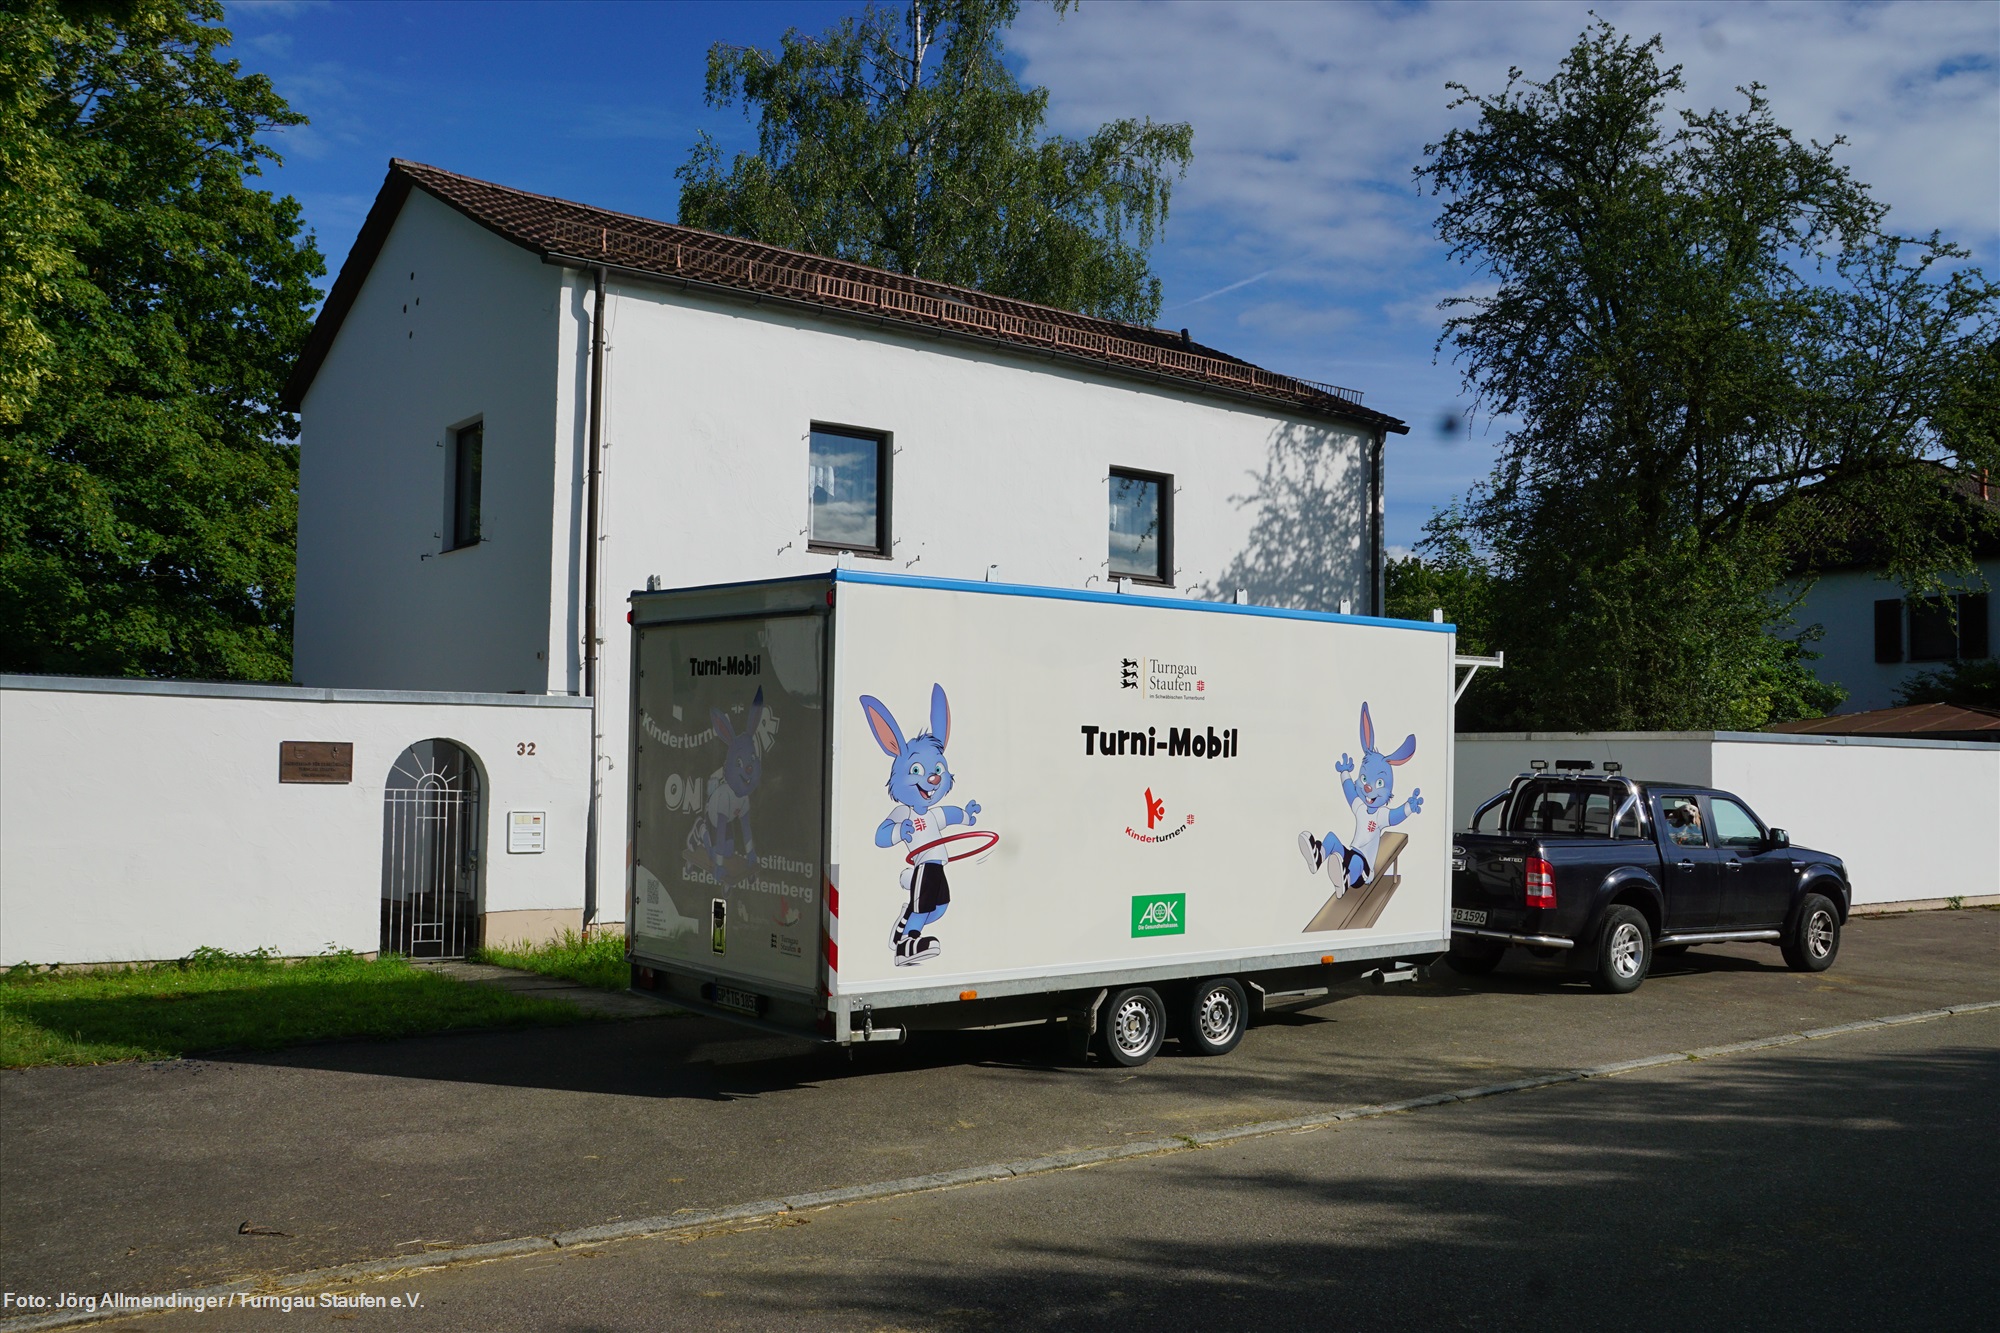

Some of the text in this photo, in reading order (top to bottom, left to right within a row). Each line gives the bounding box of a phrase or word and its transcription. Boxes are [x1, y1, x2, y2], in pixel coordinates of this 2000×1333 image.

[690, 654, 761, 676] Turni-Mobil
[1149, 659, 1197, 678] Turngau
[1149, 676, 1192, 692] Staufen
[642, 711, 732, 749] Kinderturn
[516, 742, 536, 756] 32
[1081, 725, 1238, 759] Turni-Mobil
[664, 773, 703, 814] ON
[1125, 824, 1187, 843] Kinderturnen
[1139, 900, 1178, 924] AOK
[1464, 911, 1485, 923] 1596
